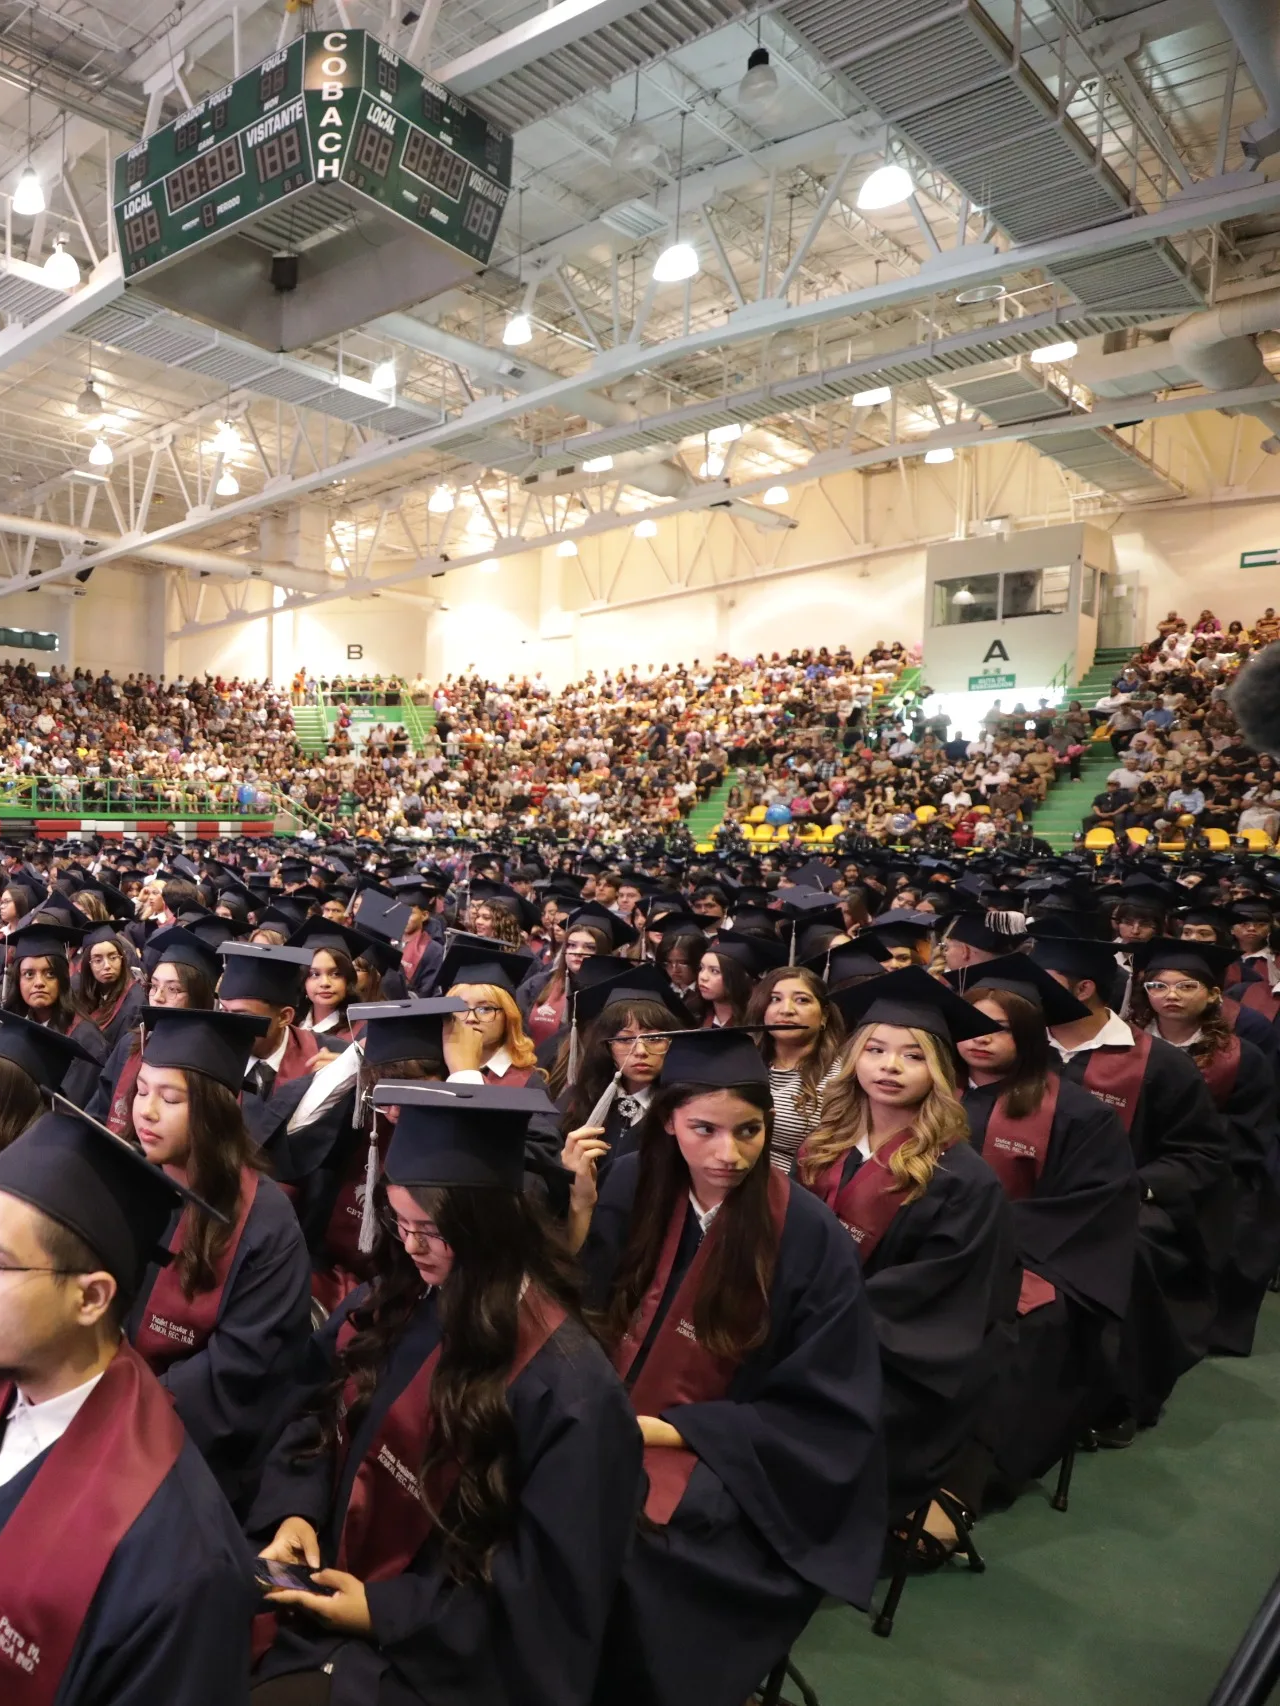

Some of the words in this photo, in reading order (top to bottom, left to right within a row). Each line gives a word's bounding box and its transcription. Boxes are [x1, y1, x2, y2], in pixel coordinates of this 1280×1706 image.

[261, 50, 288, 75] FOULS
[378, 44, 400, 68] FOULS
[208, 85, 233, 108] FOULS
[317, 31, 348, 180] COBACH
[448, 94, 467, 117] FOULS
[245, 100, 304, 149] VISITANTE
[366, 102, 397, 136] LOCAL
[127, 140, 149, 163] FOULS
[468, 170, 509, 208] VISITANTE
[123, 191, 153, 220] LOCAL
[347, 643, 364, 660] B
[981, 639, 1011, 664] A
[680, 1318, 696, 1333] Valer
[27, 1642, 41, 1665] M.
